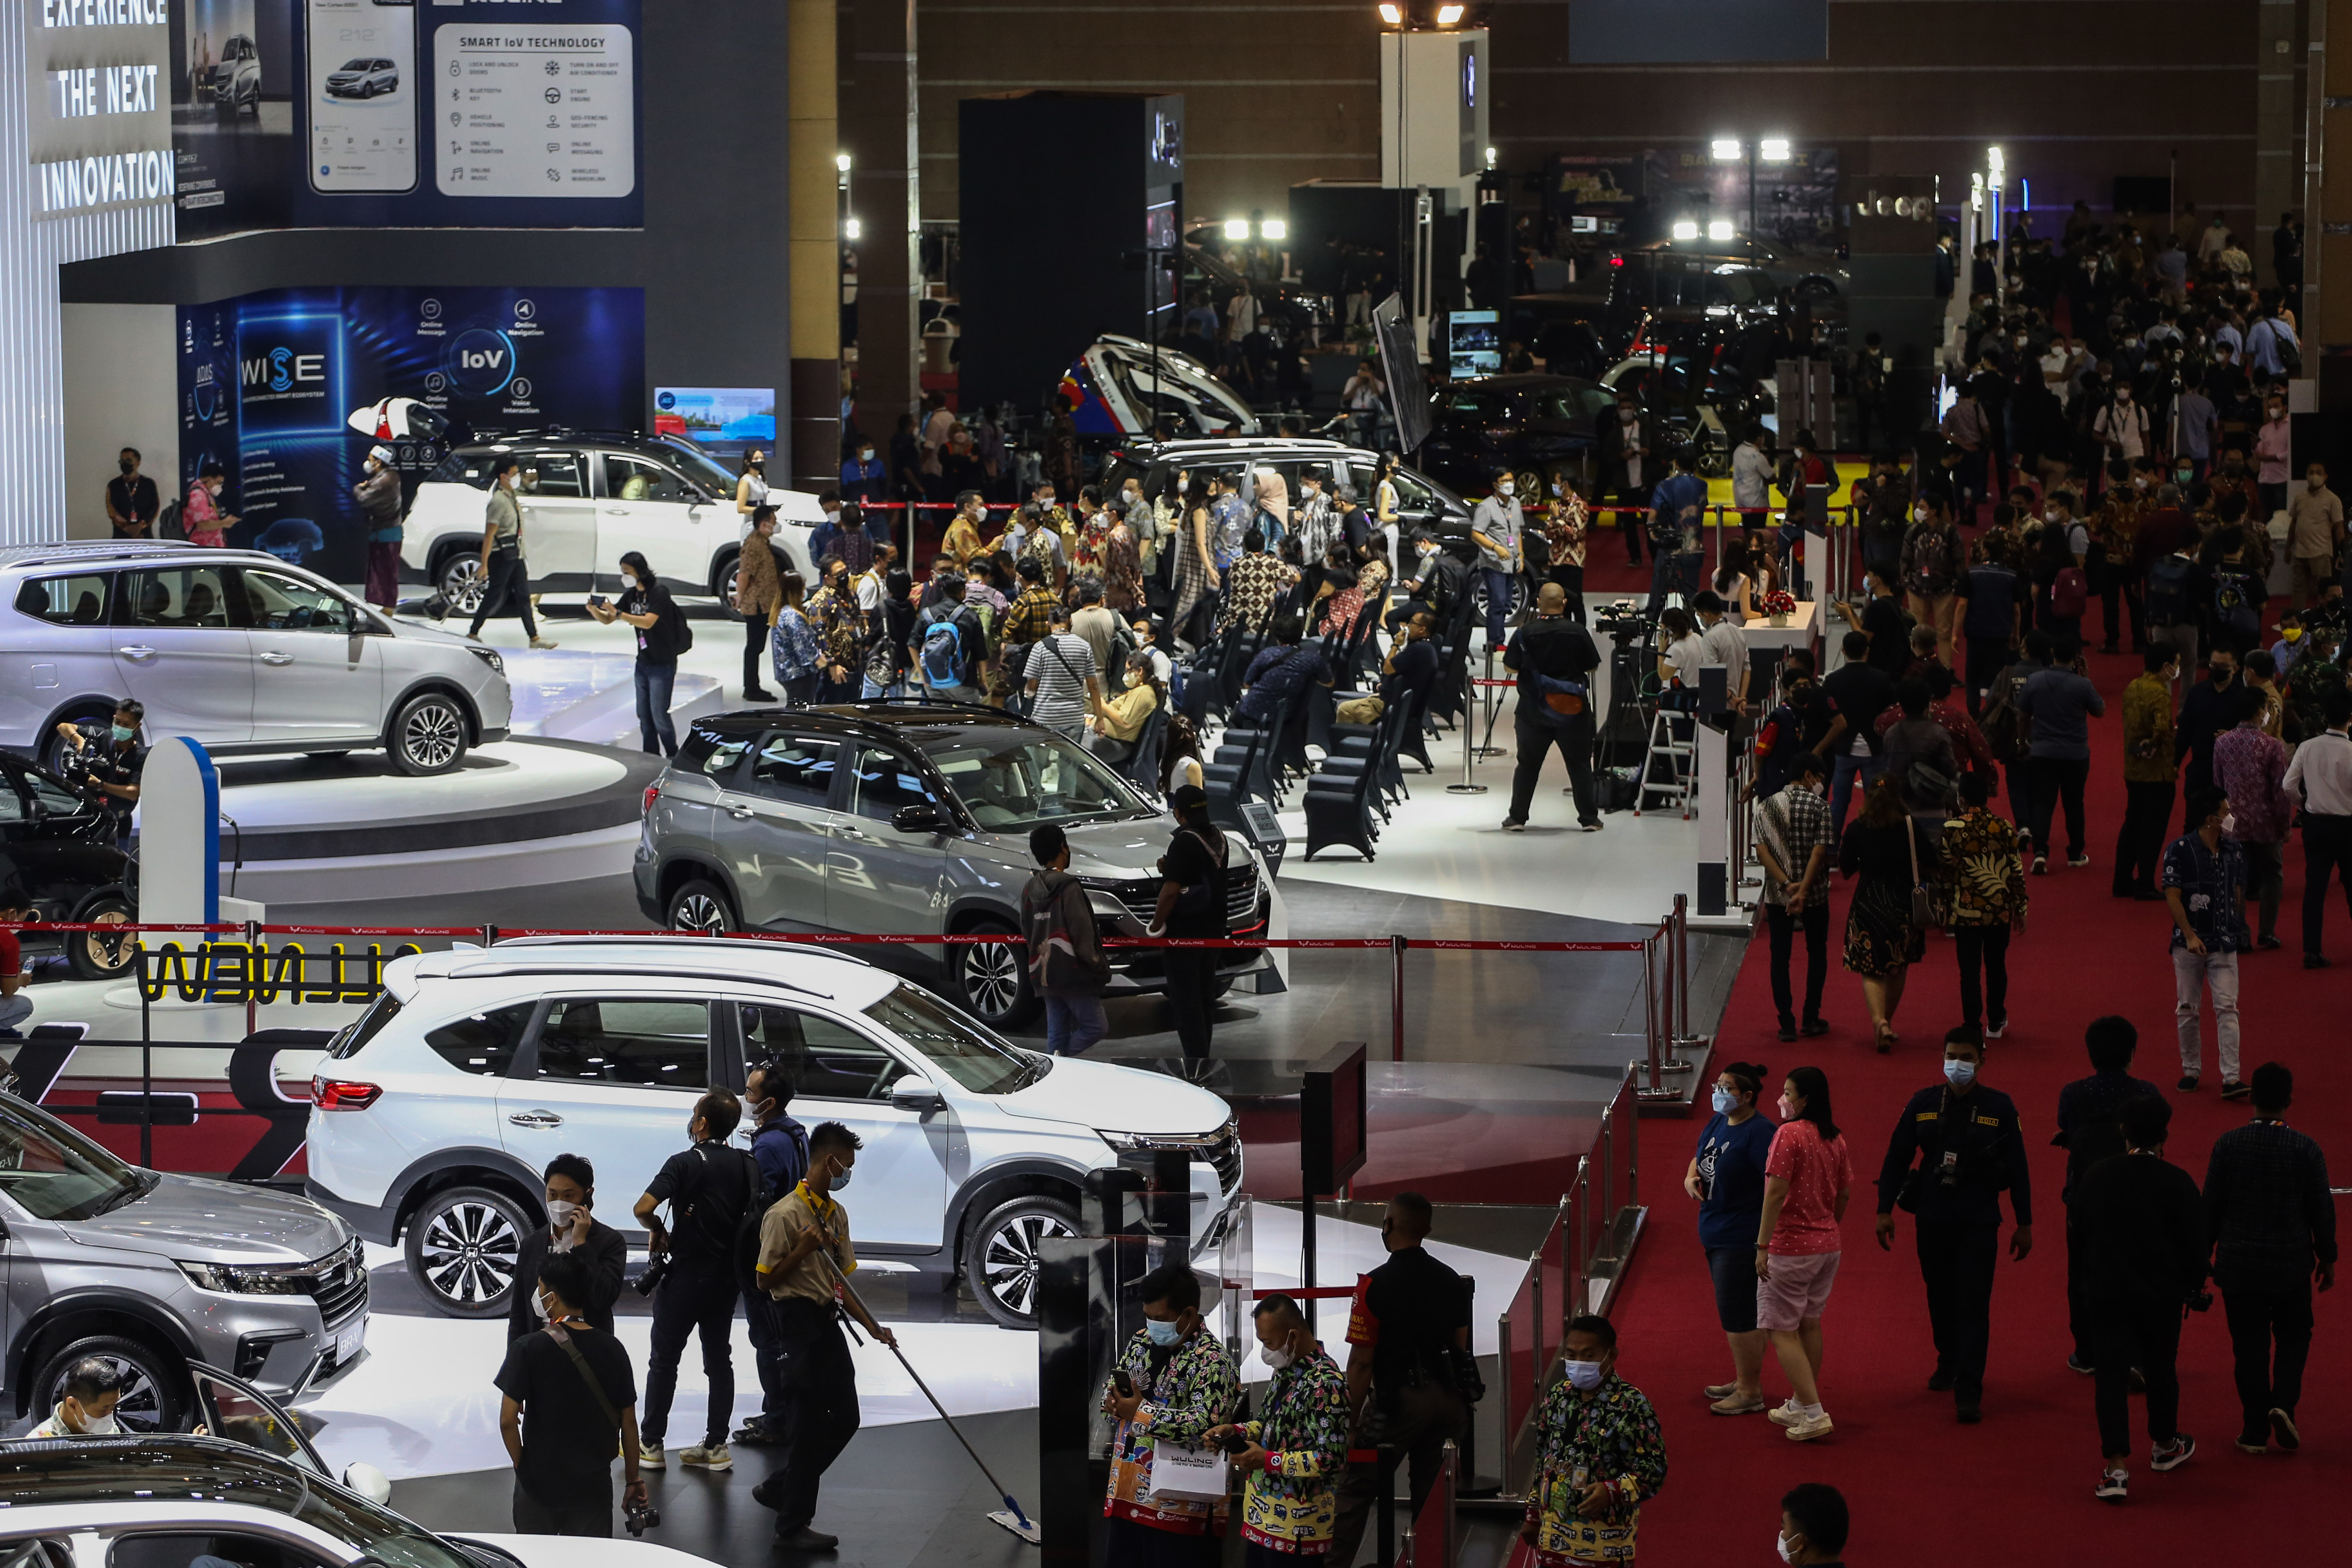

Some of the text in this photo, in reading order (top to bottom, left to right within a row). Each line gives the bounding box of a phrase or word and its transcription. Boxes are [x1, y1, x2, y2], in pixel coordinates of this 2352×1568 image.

[44, 0, 167, 28] EXPERIENCE
[340, 29, 375, 41] 212
[460, 37, 605, 48] SMART IoV TECHNOLOGY
[58, 65, 157, 118] THE NEXT
[41, 149, 174, 211] INNOVATION
[1857, 190, 1932, 221] Jeep
[461, 349, 504, 369] IoV
[196, 363, 213, 383] ADAS
[241, 347, 325, 392] WISE
[292, 391, 325, 399] ECOSYSTEM
[1352, 1314, 1364, 1324] WAS
[340, 1328, 361, 1354] BR-V
[1171, 1456, 1213, 1465] WULING
